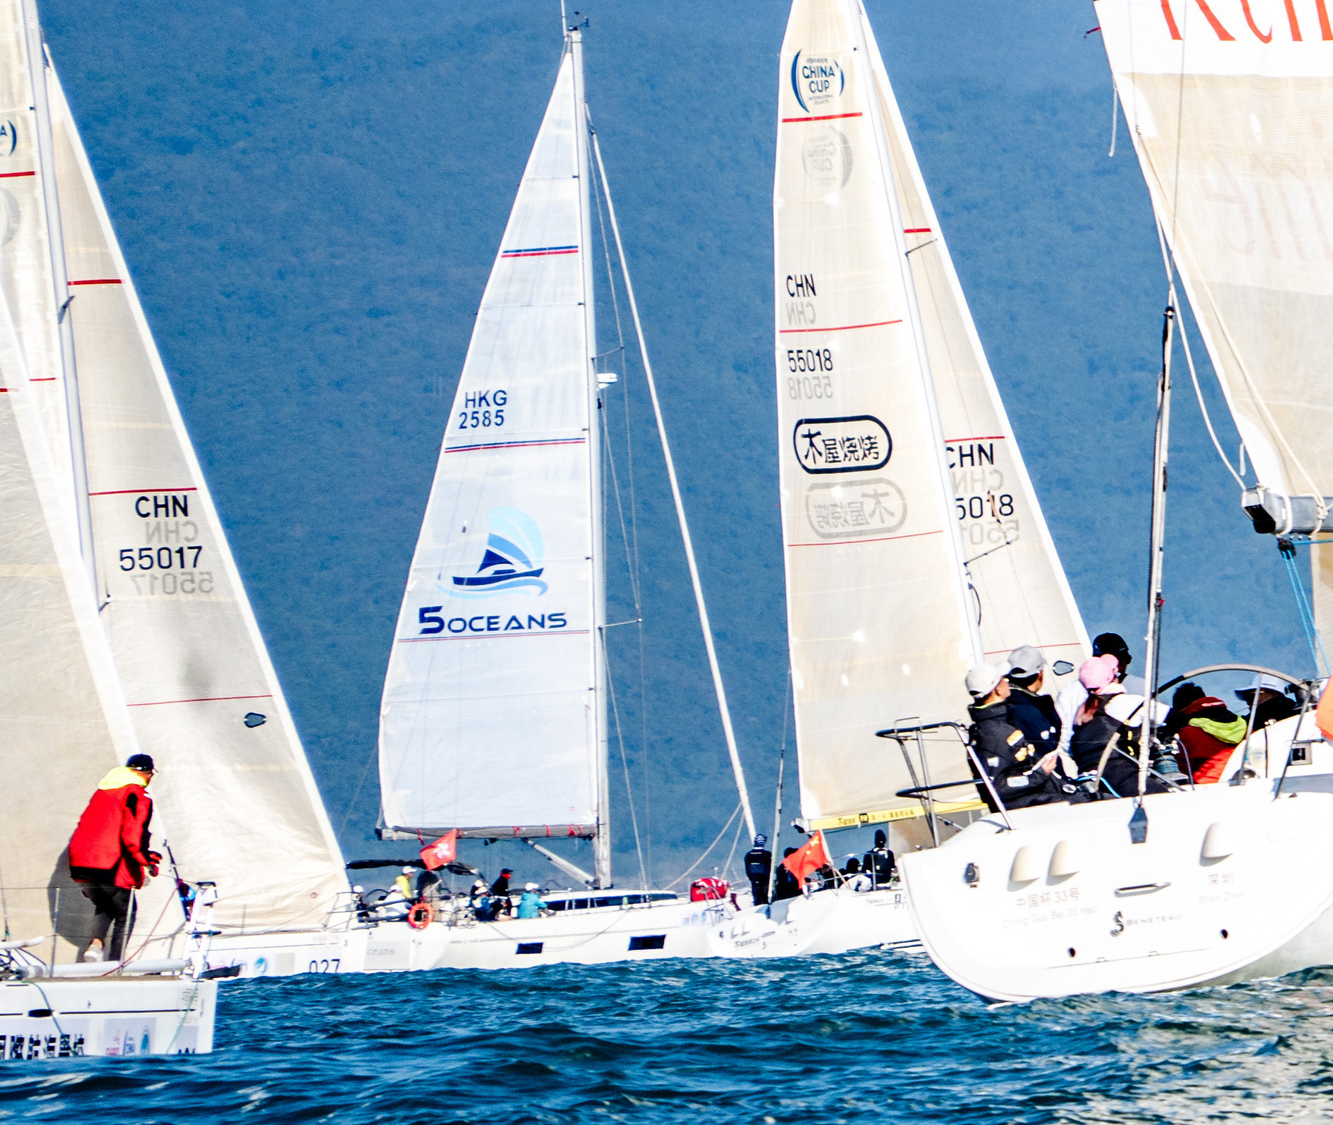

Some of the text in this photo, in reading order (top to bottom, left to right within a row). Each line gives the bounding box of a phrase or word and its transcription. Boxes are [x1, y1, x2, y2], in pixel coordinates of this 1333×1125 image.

[802, 65, 835, 79] CHINA
[809, 80, 830, 94] CUP
[786, 274, 817, 297] CHN
[787, 348, 833, 372] 55018
[464, 389, 507, 409] HKG
[458, 409, 505, 429] 2585
[801, 428, 880, 464] 木屋烧烤
[946, 443, 994, 469] CHN
[135, 494, 189, 518] CHN
[119, 545, 202, 571] 55017
